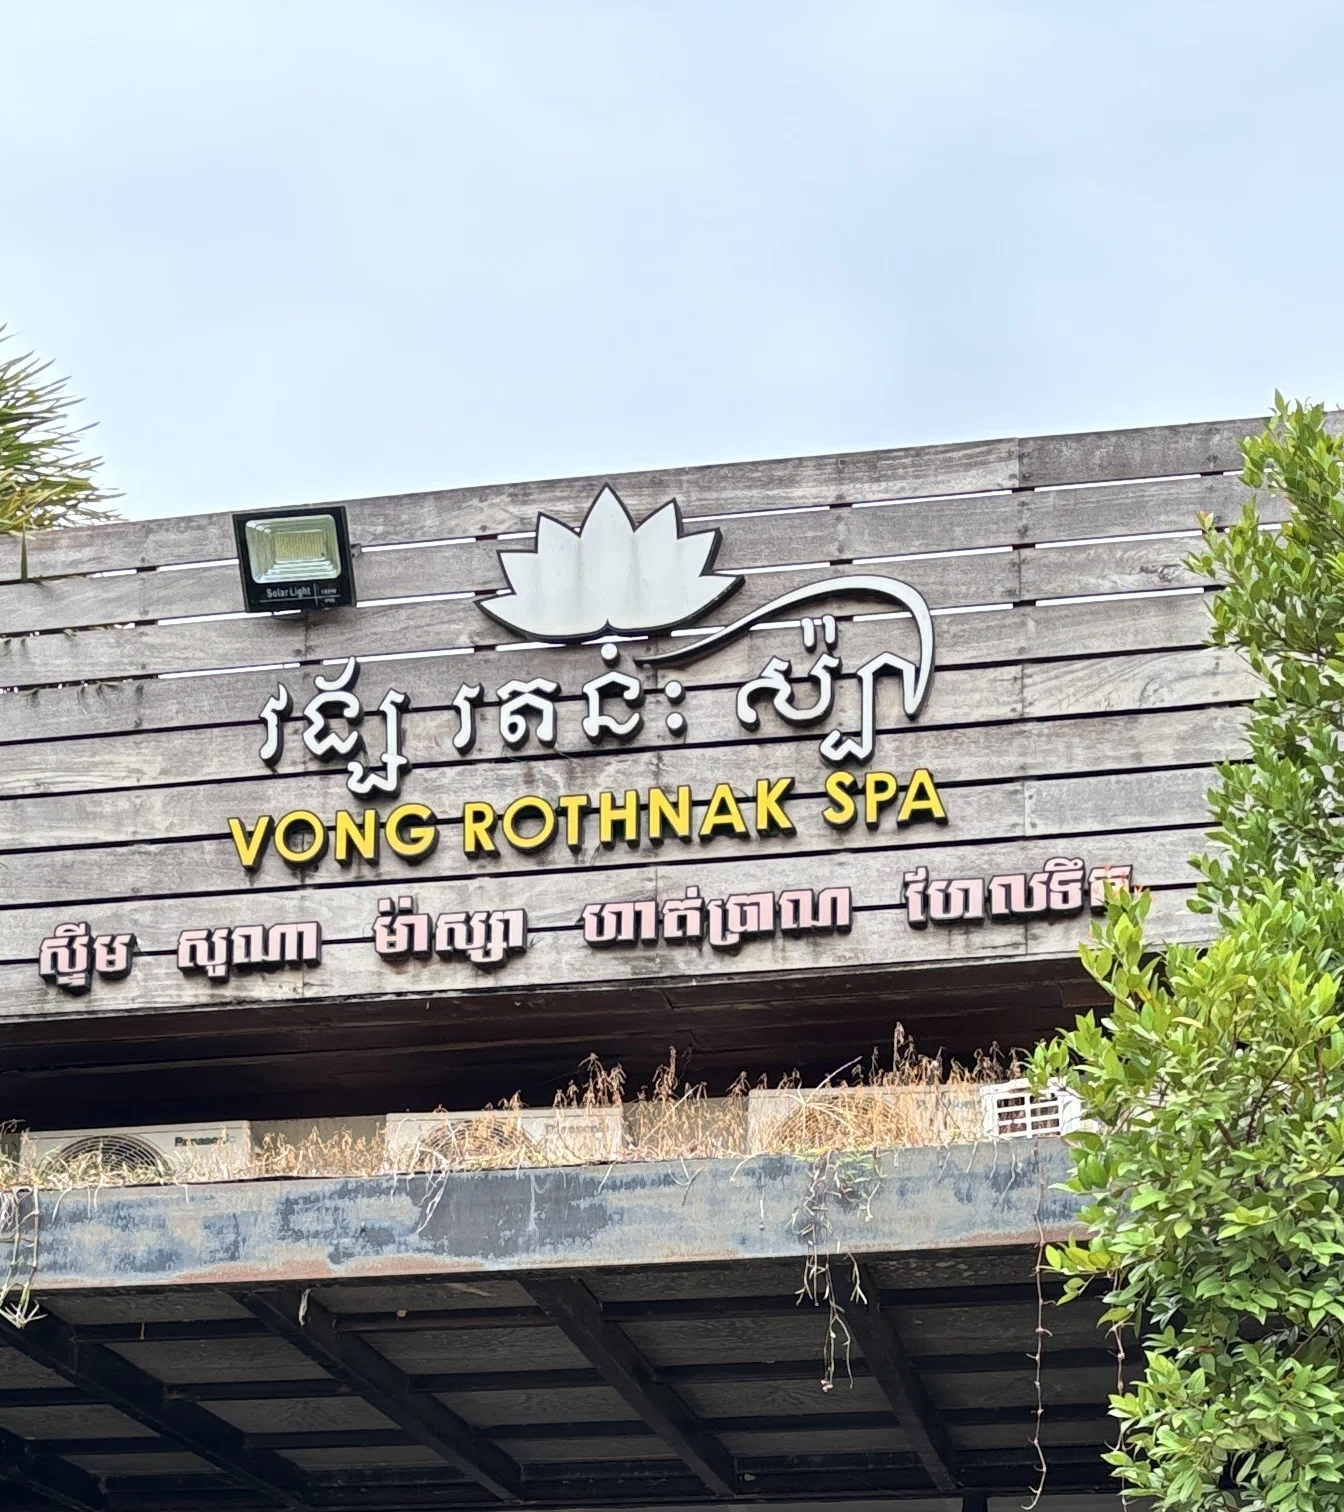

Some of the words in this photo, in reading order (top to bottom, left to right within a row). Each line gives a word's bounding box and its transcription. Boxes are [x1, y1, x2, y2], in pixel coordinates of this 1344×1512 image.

[266, 588, 289, 599] Solar
[289, 585, 312, 599] Light
[229, 804, 439, 871] VONG
[463, 777, 797, 859] ROTHNAK
[822, 768, 948, 829] SPA
[177, 920, 321, 983] សូណា
